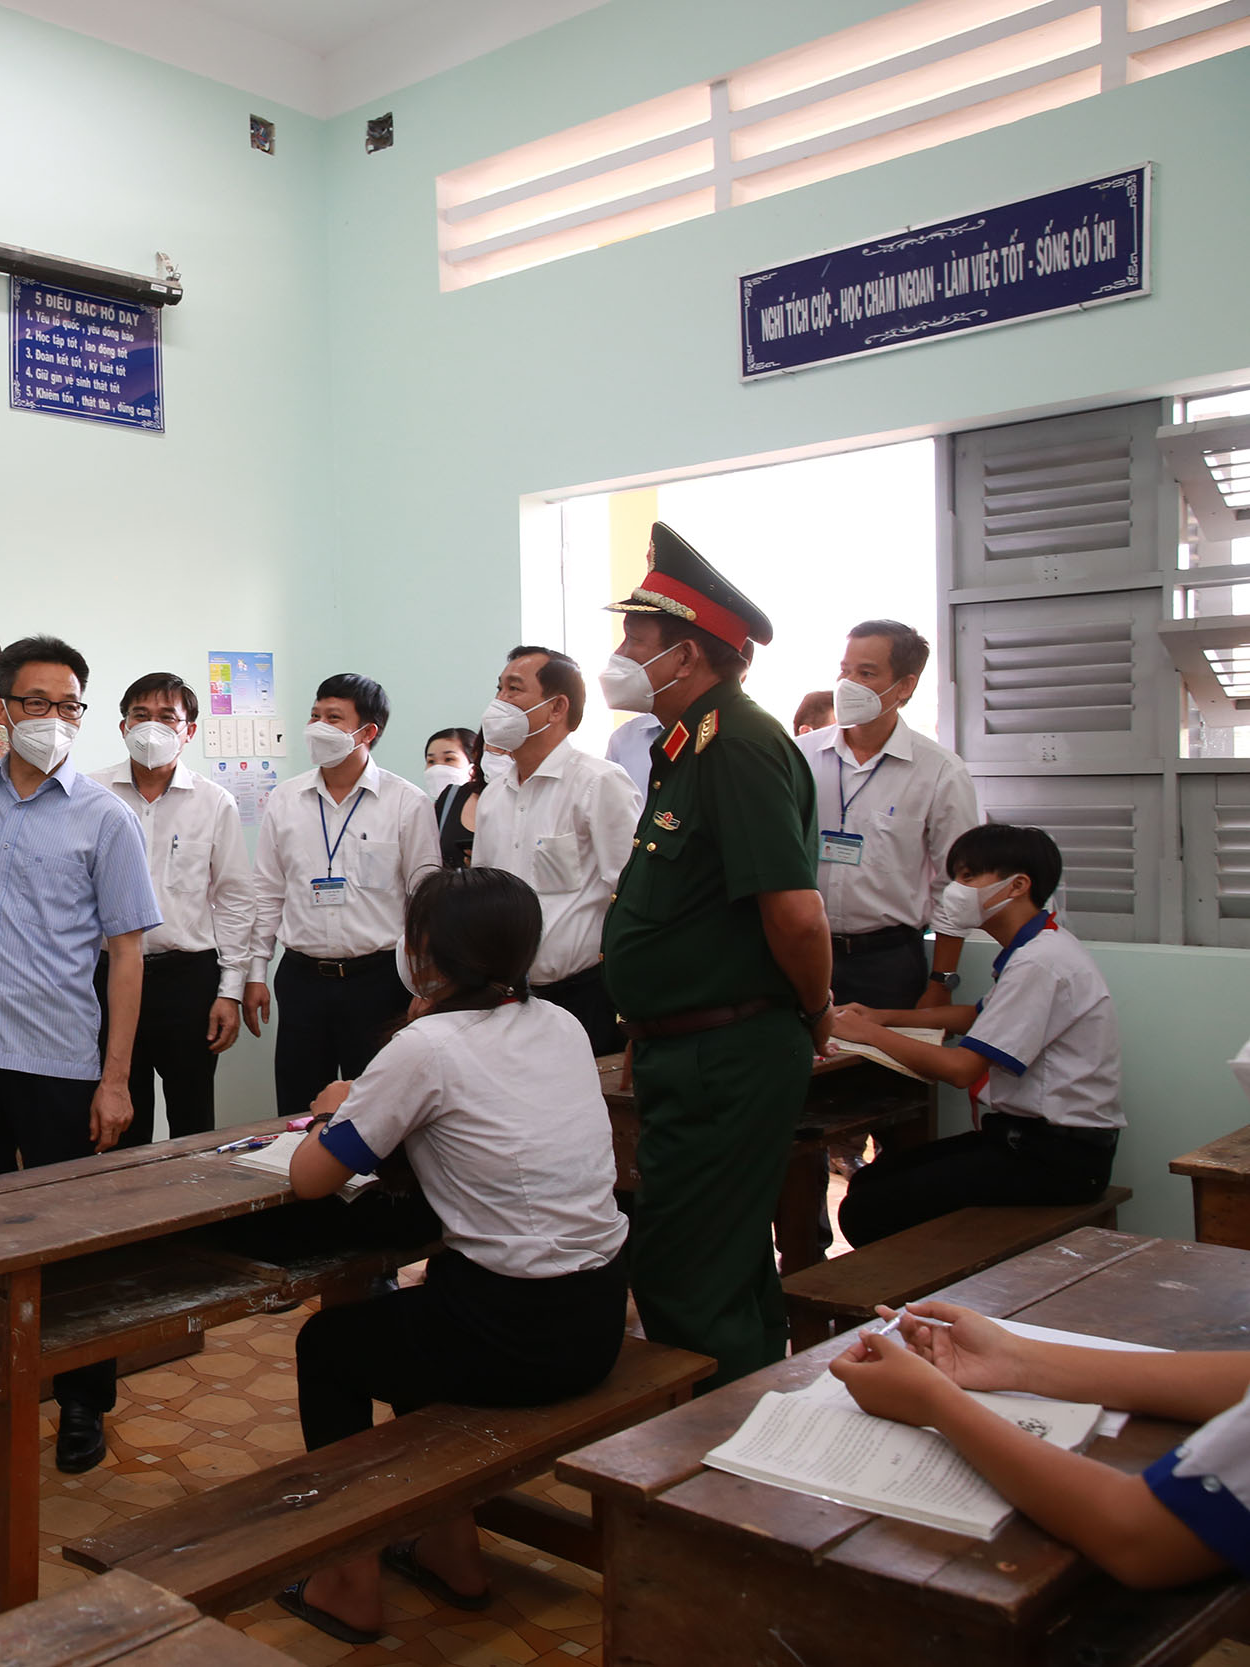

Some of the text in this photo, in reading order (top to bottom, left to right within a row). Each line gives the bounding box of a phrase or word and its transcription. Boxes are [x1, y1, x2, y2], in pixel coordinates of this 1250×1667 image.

[761, 296, 785, 342] NGHĨ
[785, 292, 810, 336] TÍCH
[811, 287, 832, 336] CỰC
[840, 284, 863, 329] HỌC
[864, 271, 896, 318] CHĂM
[897, 265, 935, 310] NGOAN
[944, 250, 969, 298] LÀM
[971, 241, 999, 297] VIỆC
[1001, 228, 1025, 285] TỐT
[1036, 219, 1070, 277] SỐNG
[1072, 215, 1090, 268] CÓ
[1094, 213, 1116, 263] ÍCH
[26, 309, 33, 321] 1.
[35, 310, 50, 325] Yêu
[35, 291, 42, 305] 5
[75, 299, 97, 317] BÁC
[118, 310, 140, 329] DẠY
[25, 327, 33, 340] 2.
[35, 330, 50, 346] Học
[52, 334, 65, 349] tập
[67, 336, 78, 349] tốt
[85, 339, 96, 353] lao
[117, 346, 128, 360] tốt
[25, 346, 33, 359] 3.
[56, 352, 69, 366] kết
[71, 355, 82, 368] tốt
[116, 364, 127, 377] tốt
[25, 366, 33, 378] 4.
[76, 376, 91, 389] sinh
[93, 379, 108, 394] thật
[110, 381, 120, 394] tốt
[26, 384, 34, 397] 5.
[35, 386, 60, 402] Khiêm
[81, 395, 96, 410] thật
